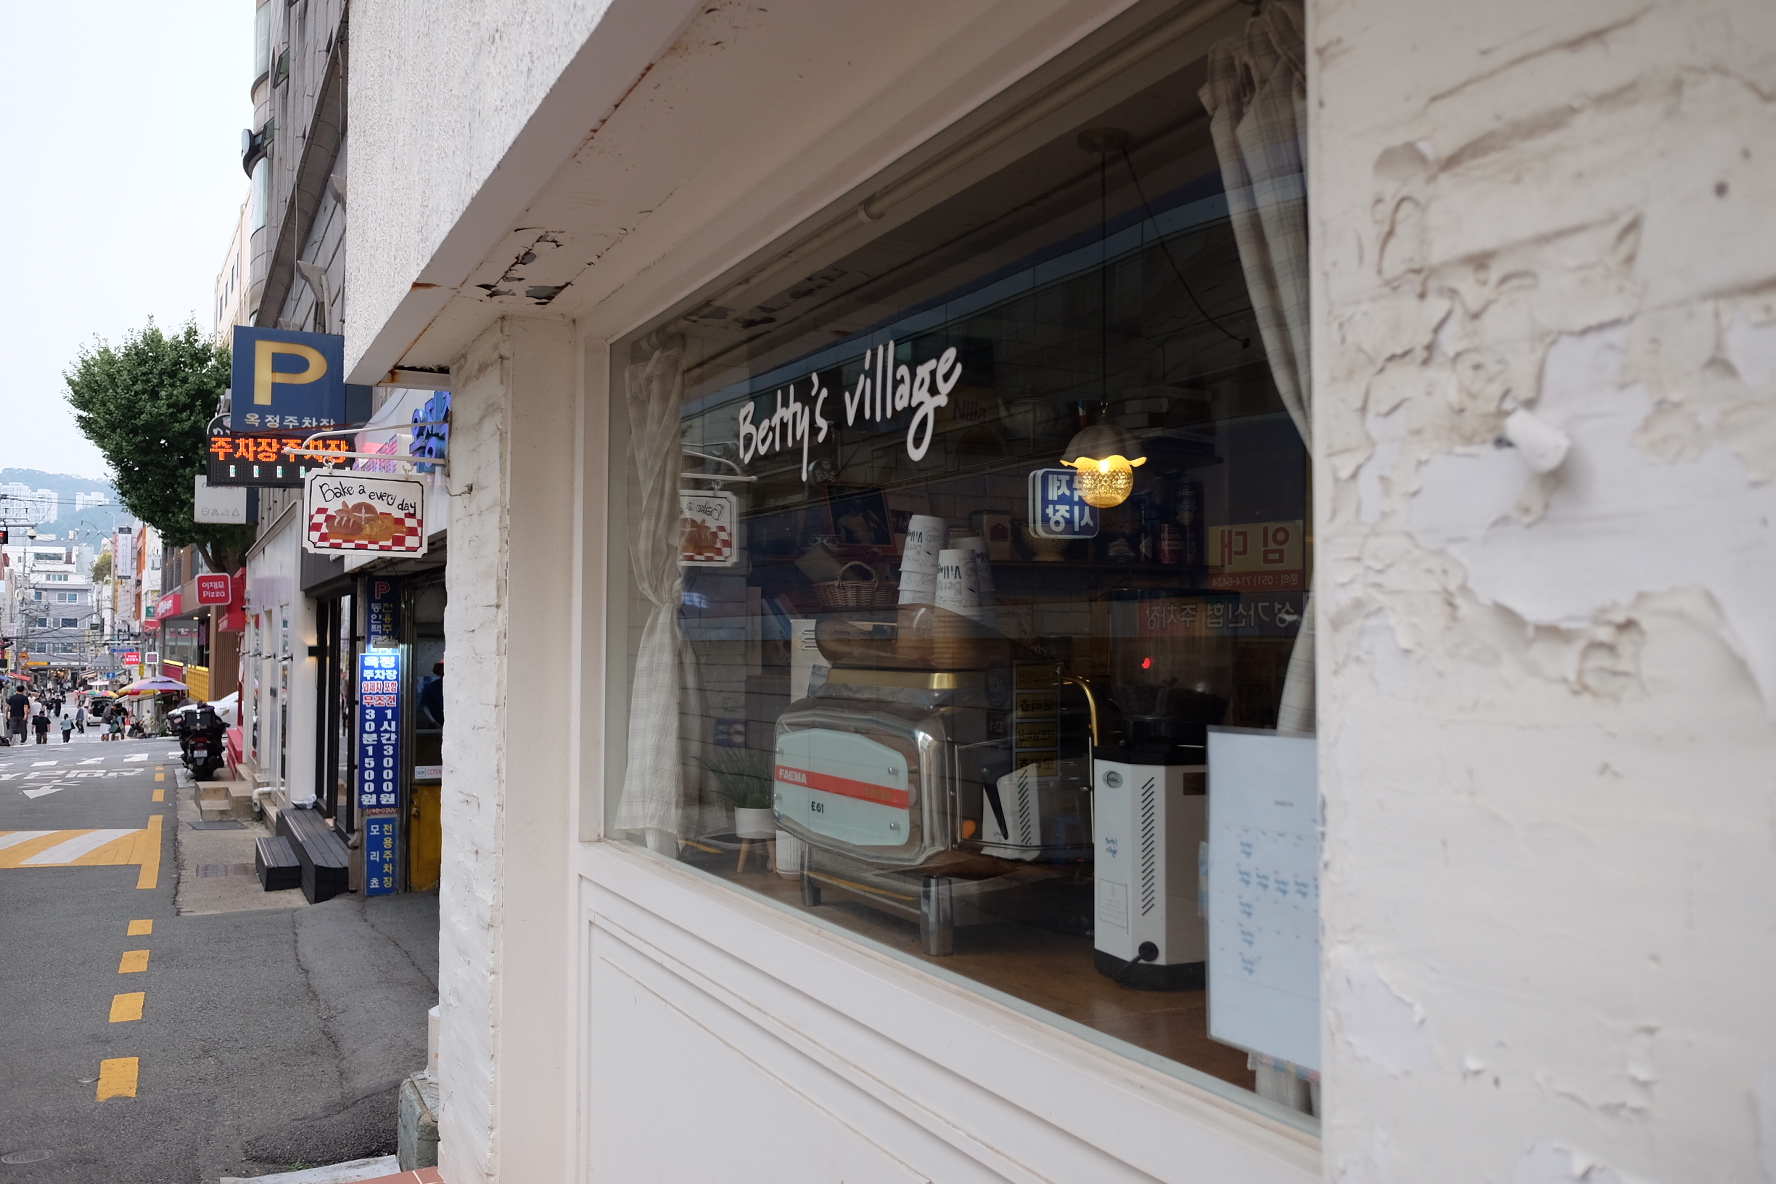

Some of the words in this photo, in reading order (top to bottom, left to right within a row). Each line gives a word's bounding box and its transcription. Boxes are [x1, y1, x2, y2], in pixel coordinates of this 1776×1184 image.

[254, 340, 327, 405] P
[739, 372, 828, 482] Betty's
[845, 340, 963, 462] village
[244, 413, 336, 431] 옥정주차장
[319, 481, 354, 502] Bake
[358, 485, 366, 495] a
[369, 490, 397, 506] every
[397, 499, 416, 516] day
[202, 581, 225, 590] 이재모
[202, 590, 226, 598] Pizza
[375, 581, 390, 599] P
[364, 656, 395, 668] 옥정
[363, 669, 397, 680] 주차장
[384, 682, 398, 693] 포함
[363, 695, 397, 707] 무조건
[779, 768, 807, 784] FAEMA
[370, 825, 380, 889] 모리쵸
[383, 824, 393, 889] 전용주차장
